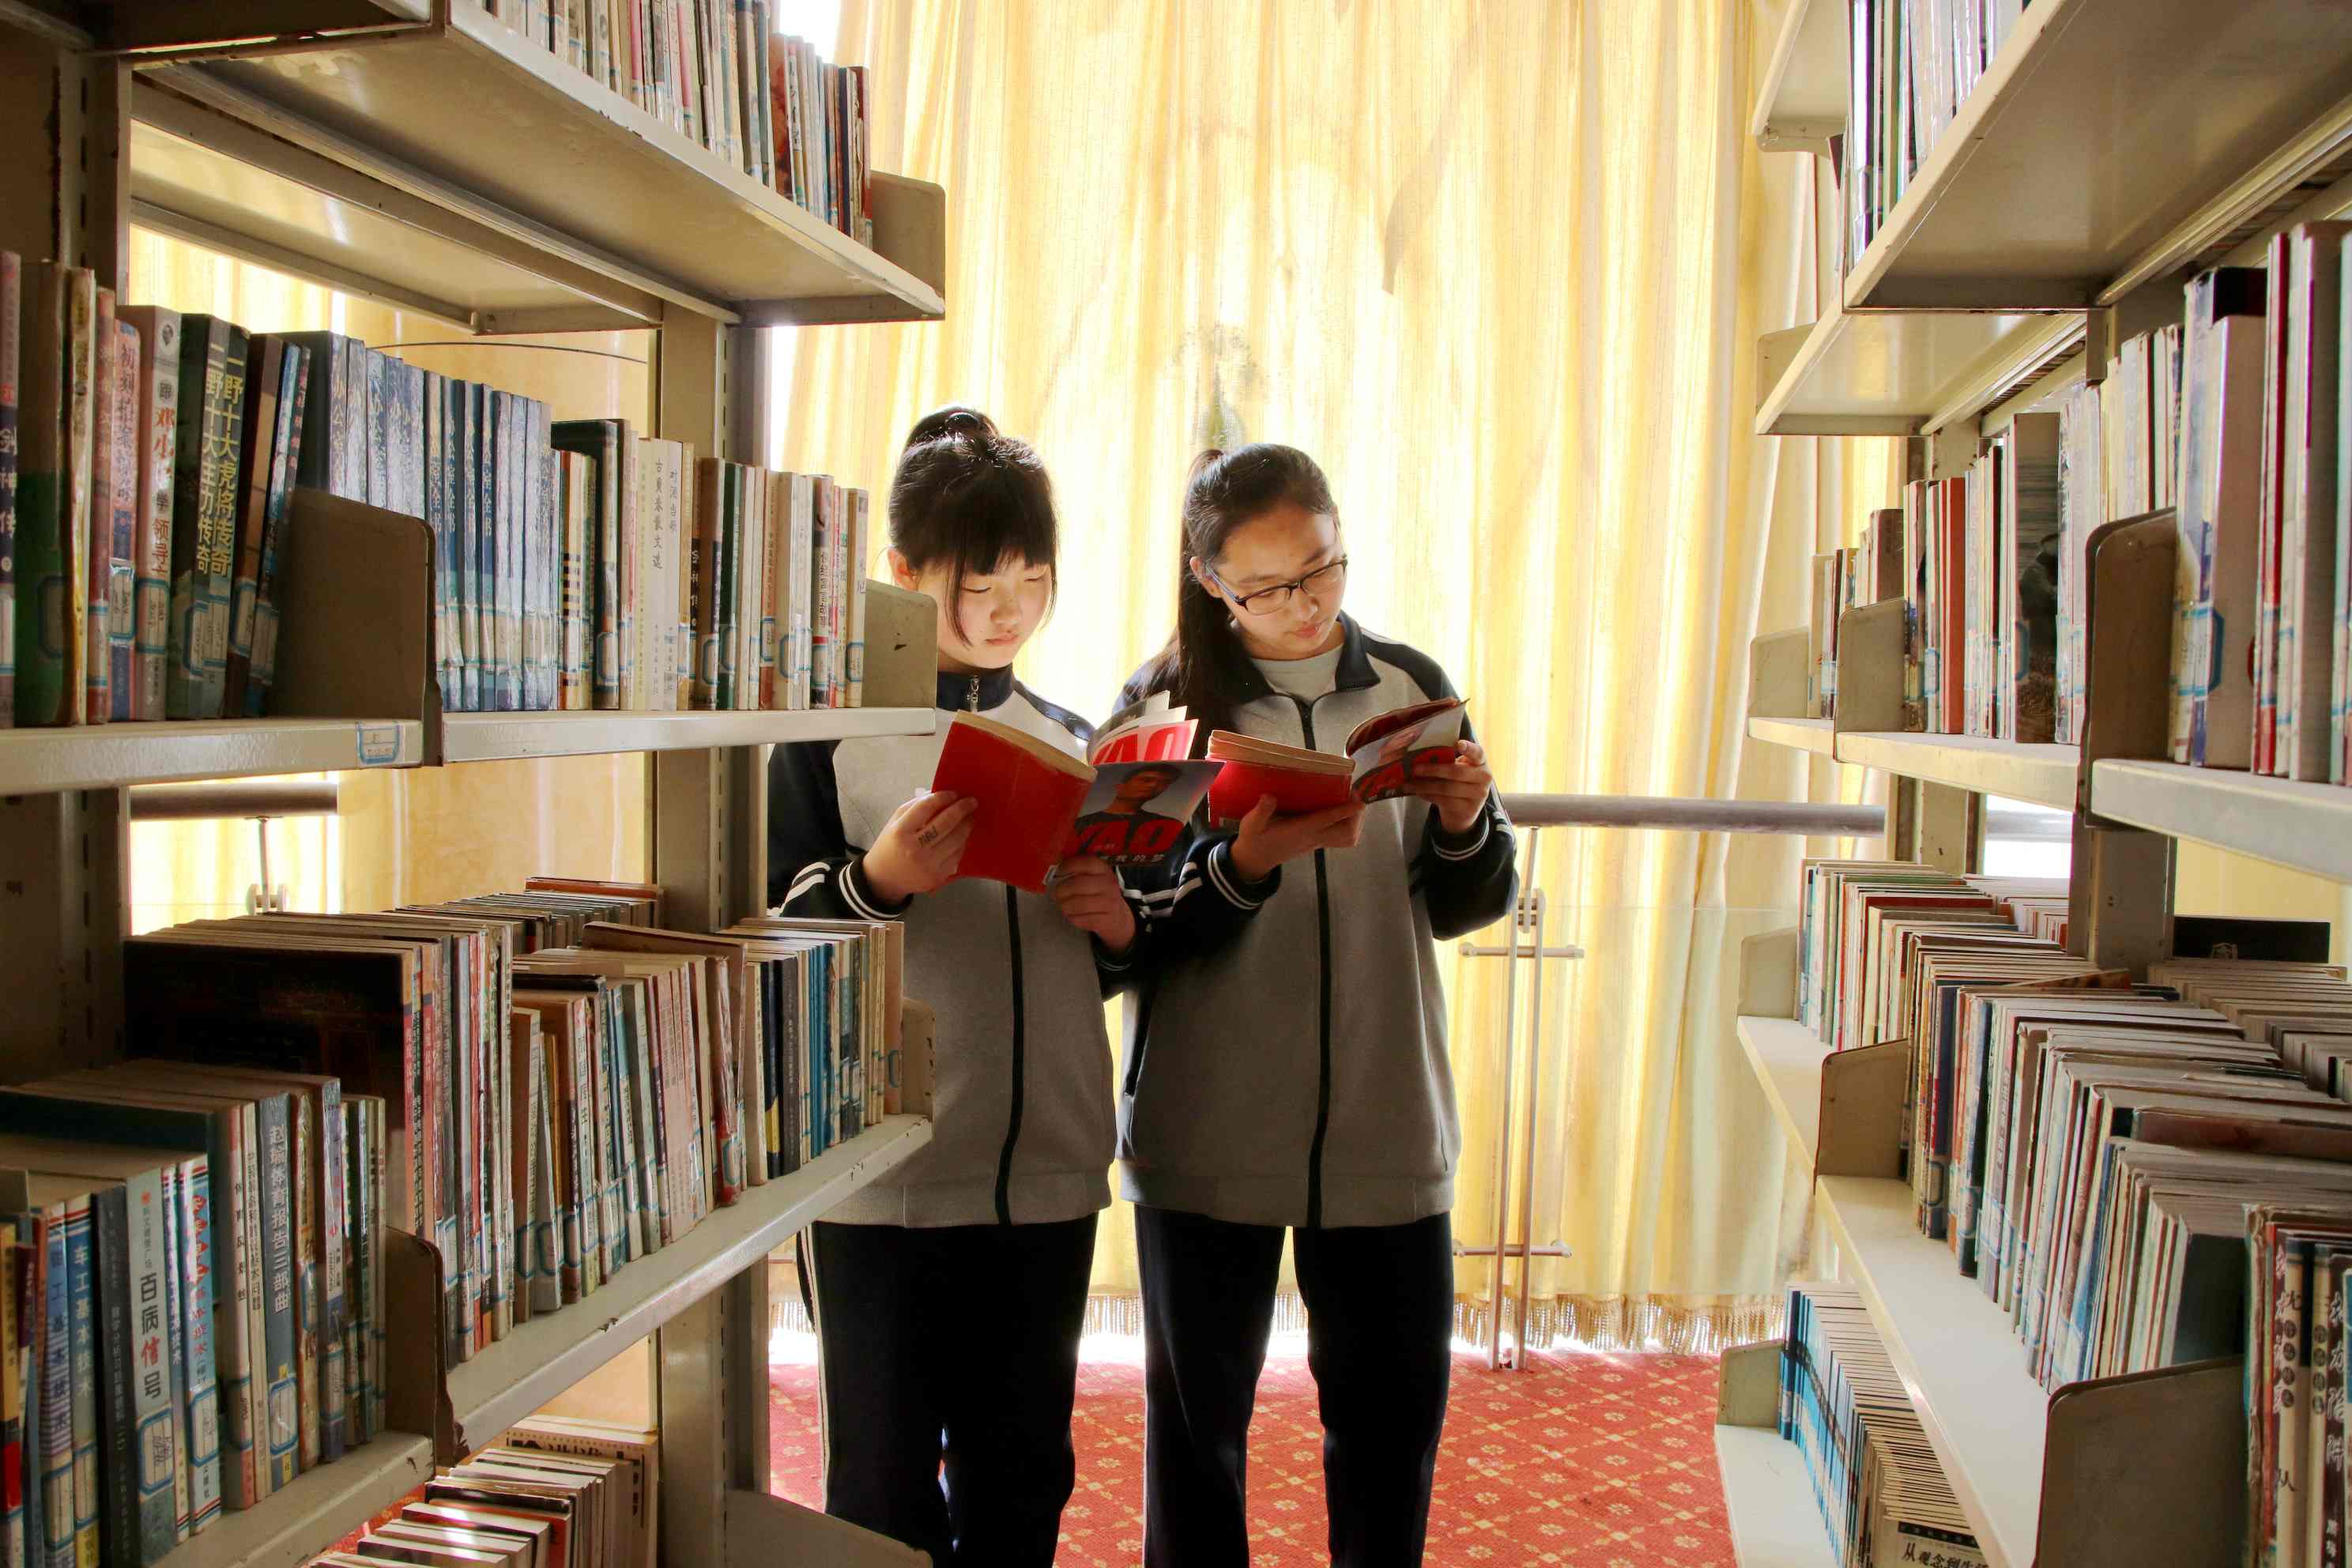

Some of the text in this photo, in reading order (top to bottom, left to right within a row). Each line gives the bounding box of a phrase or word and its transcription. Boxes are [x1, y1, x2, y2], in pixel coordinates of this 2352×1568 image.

[269, 1124, 292, 1314] 赵瑜体育报告三部曲
[74, 1243, 93, 1398] 车工基本技术
[139, 1271, 162, 1400] 百病信号
